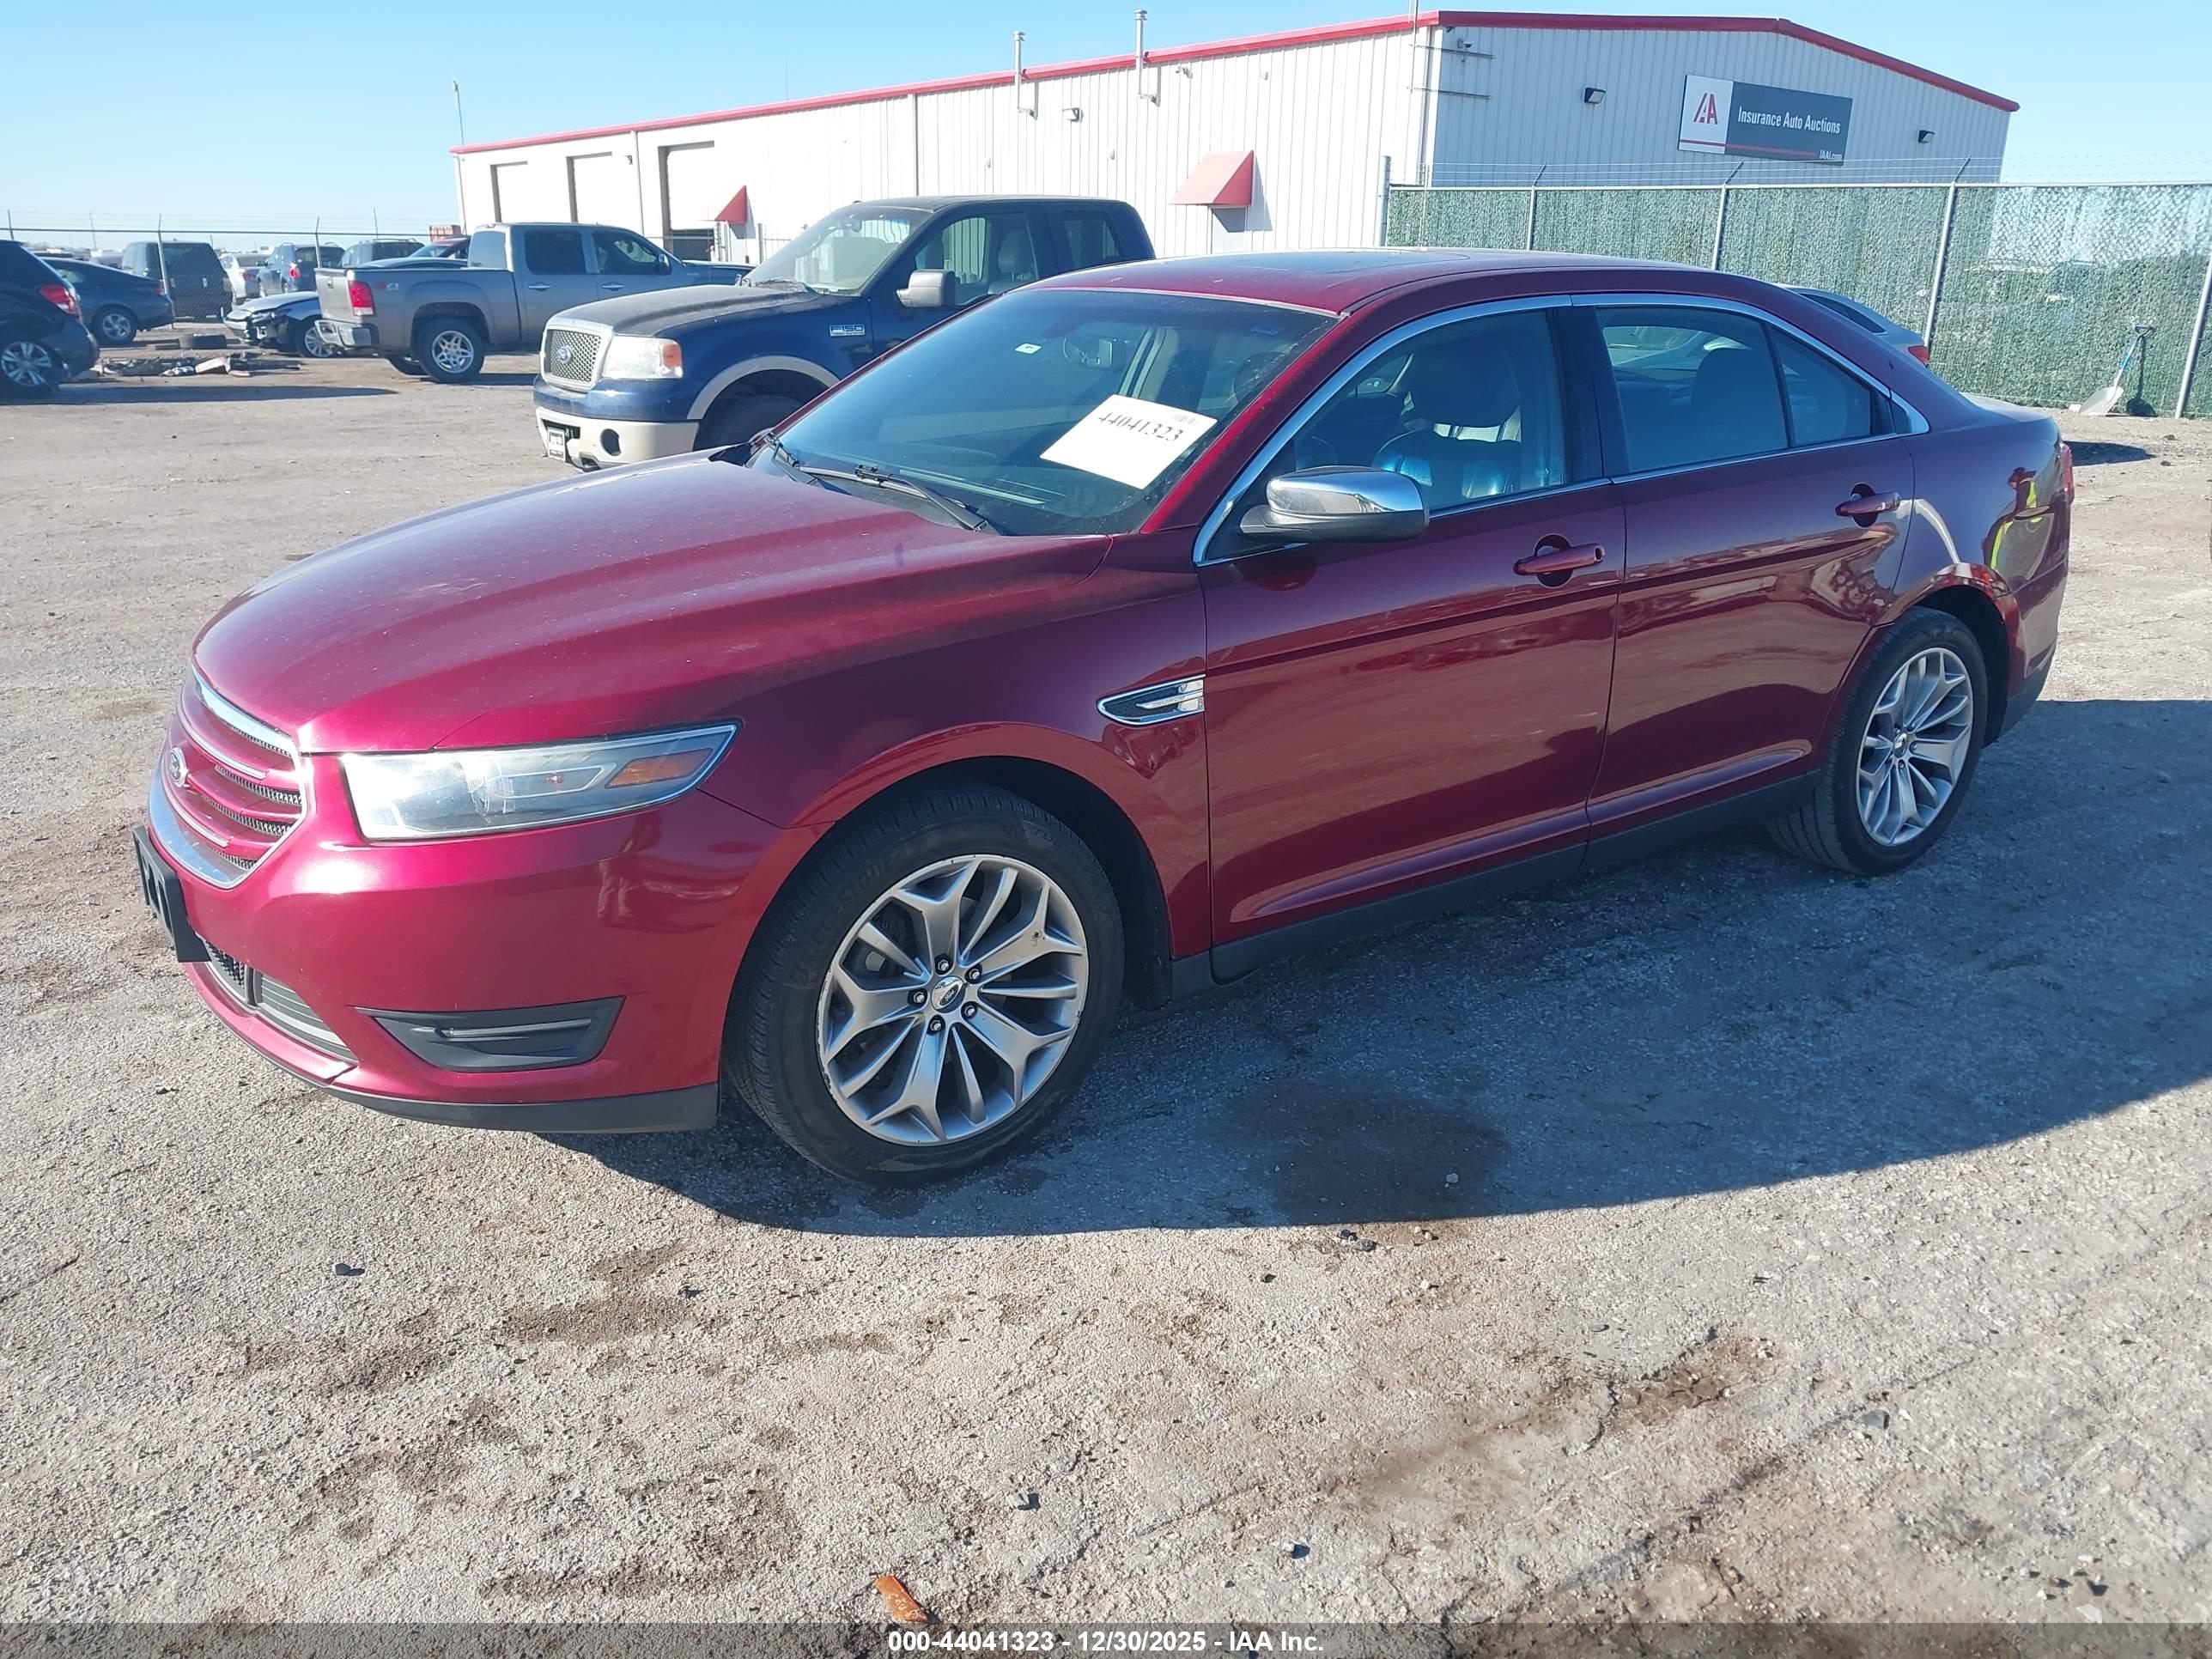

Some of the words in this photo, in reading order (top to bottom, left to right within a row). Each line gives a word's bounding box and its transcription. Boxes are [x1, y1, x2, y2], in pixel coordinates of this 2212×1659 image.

[1738, 106, 1782, 126] Insurance
[1784, 112, 1803, 130] Auto
[1804, 115, 1841, 134] Auctions
[1097, 412, 1184, 441] 44041323
